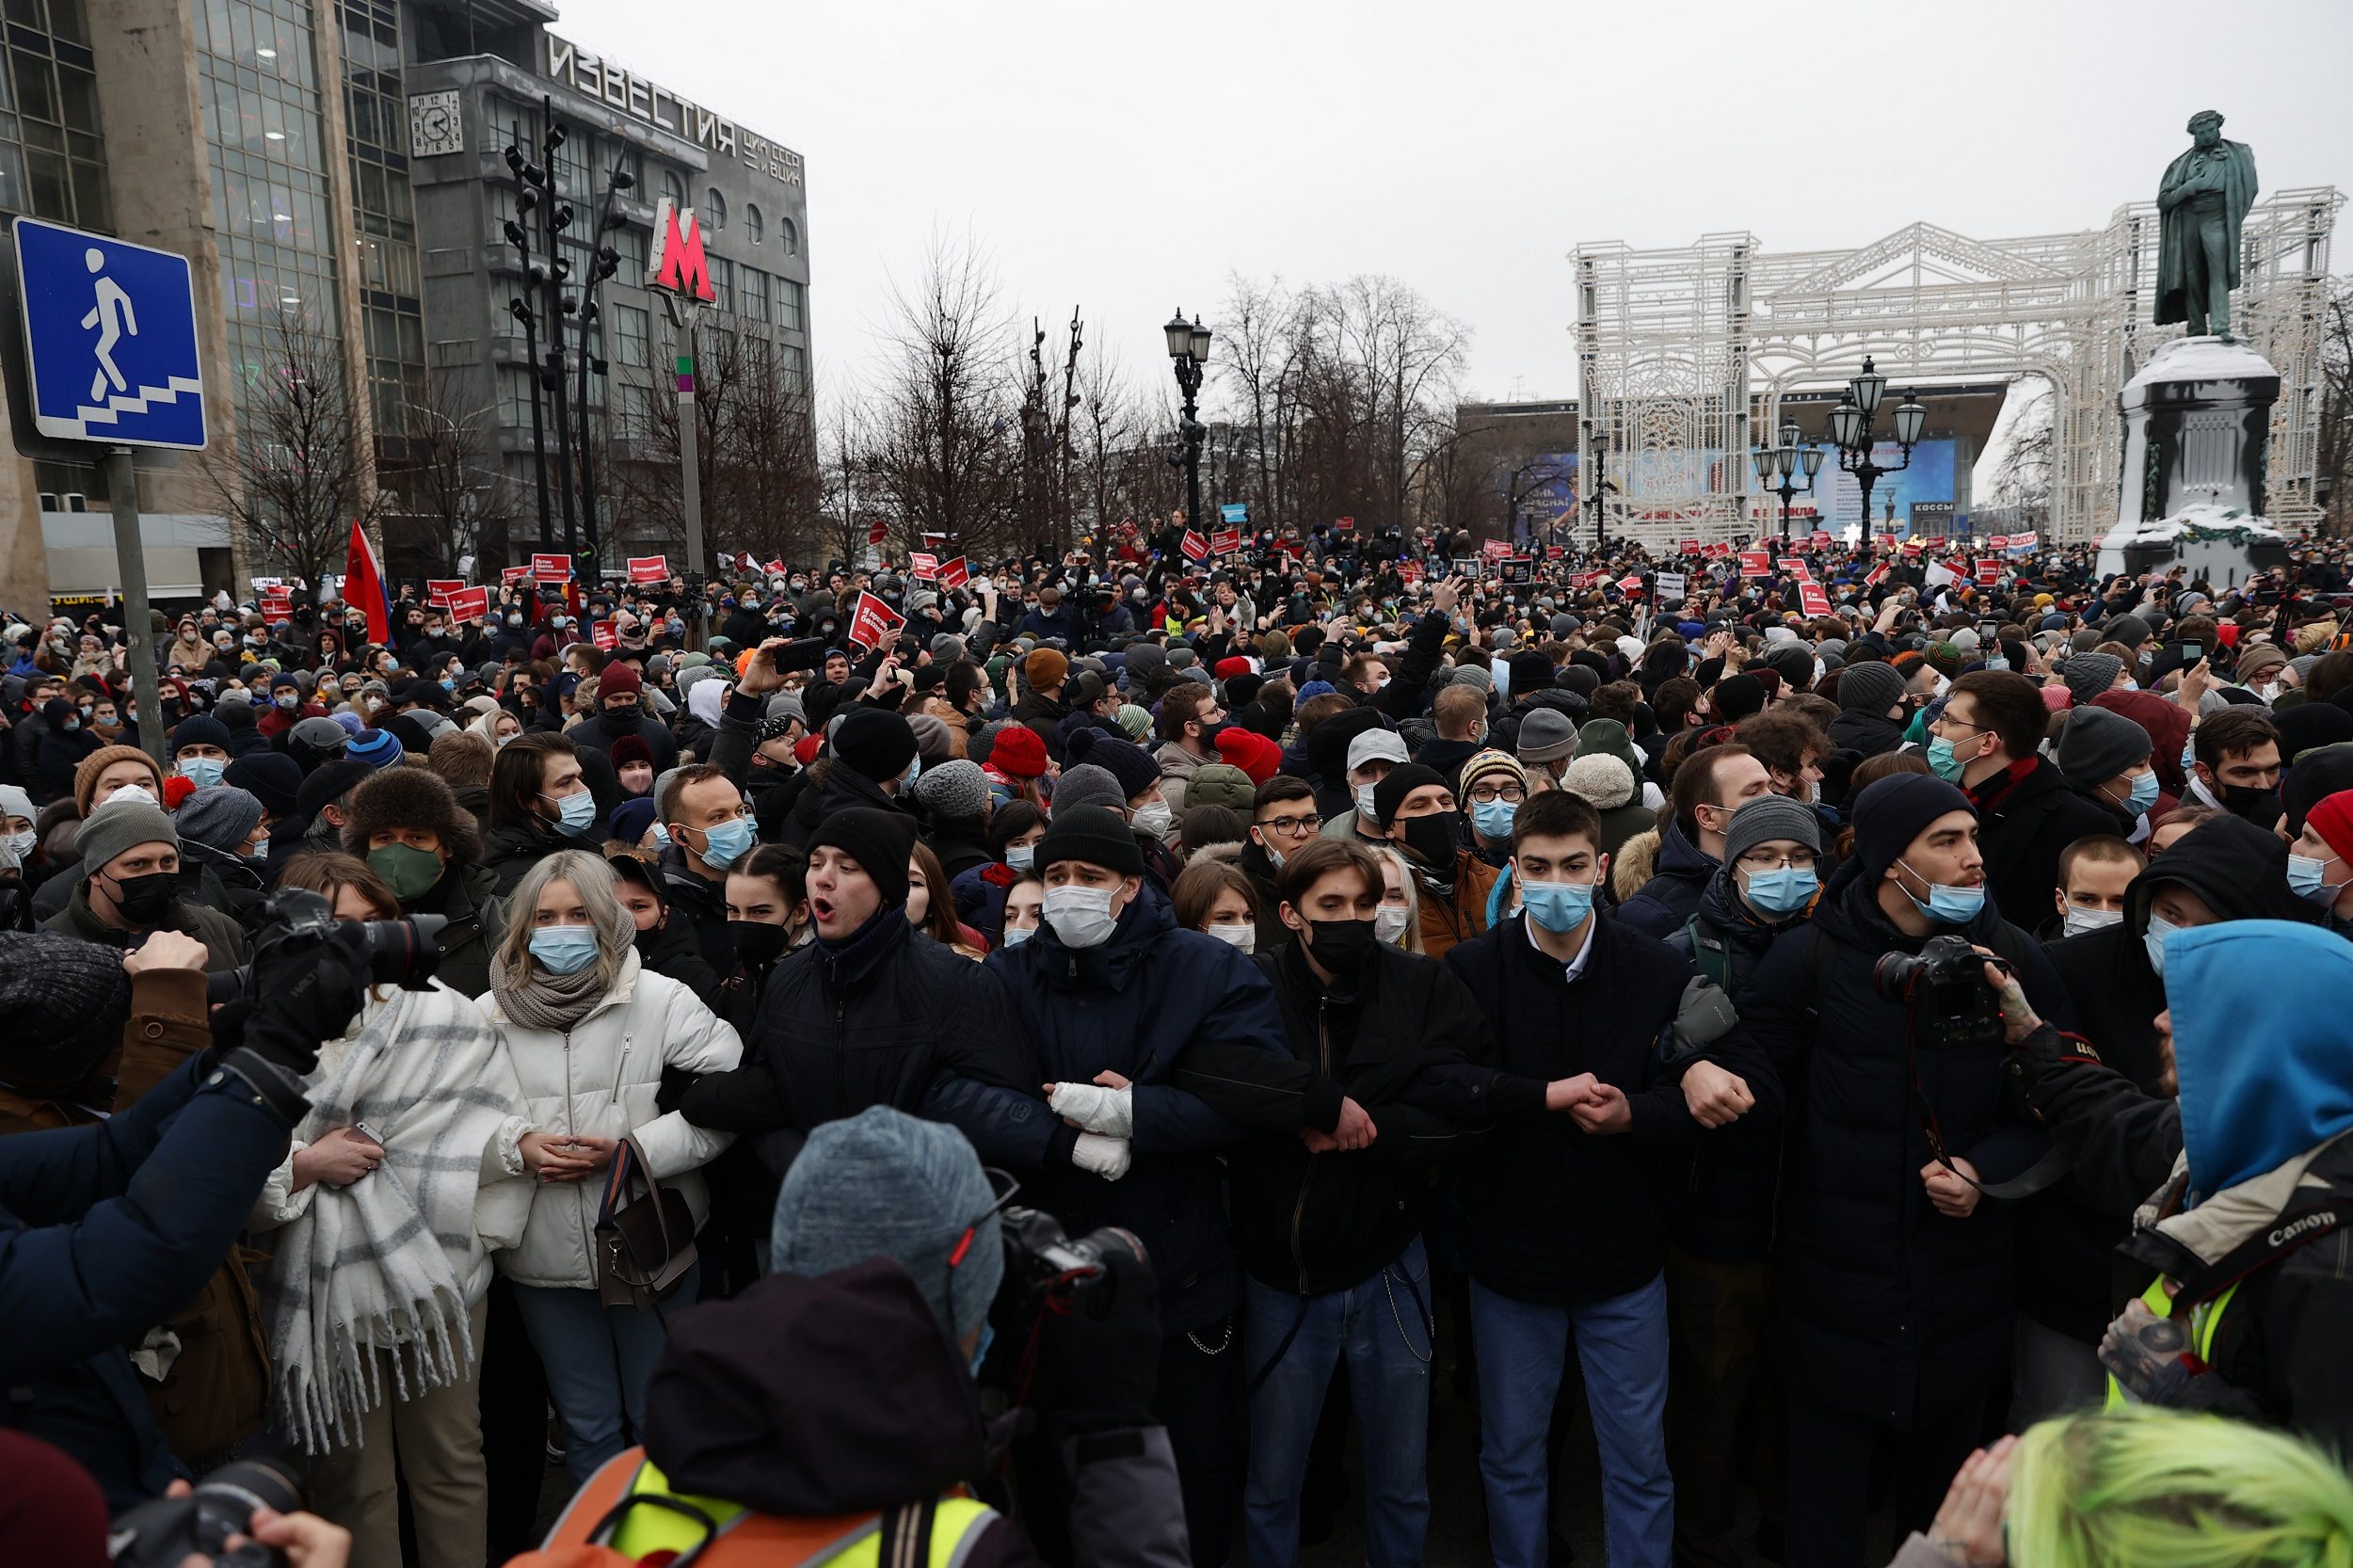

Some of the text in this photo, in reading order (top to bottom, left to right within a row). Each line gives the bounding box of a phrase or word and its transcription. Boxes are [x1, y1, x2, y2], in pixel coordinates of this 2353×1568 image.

[548, 34, 737, 158] ИЗВЕСТИЯ
[743, 132, 799, 168] ЦИК СССР
[770, 161, 800, 186] ВЦИК
[2267, 1211, 2336, 1247] Canon
